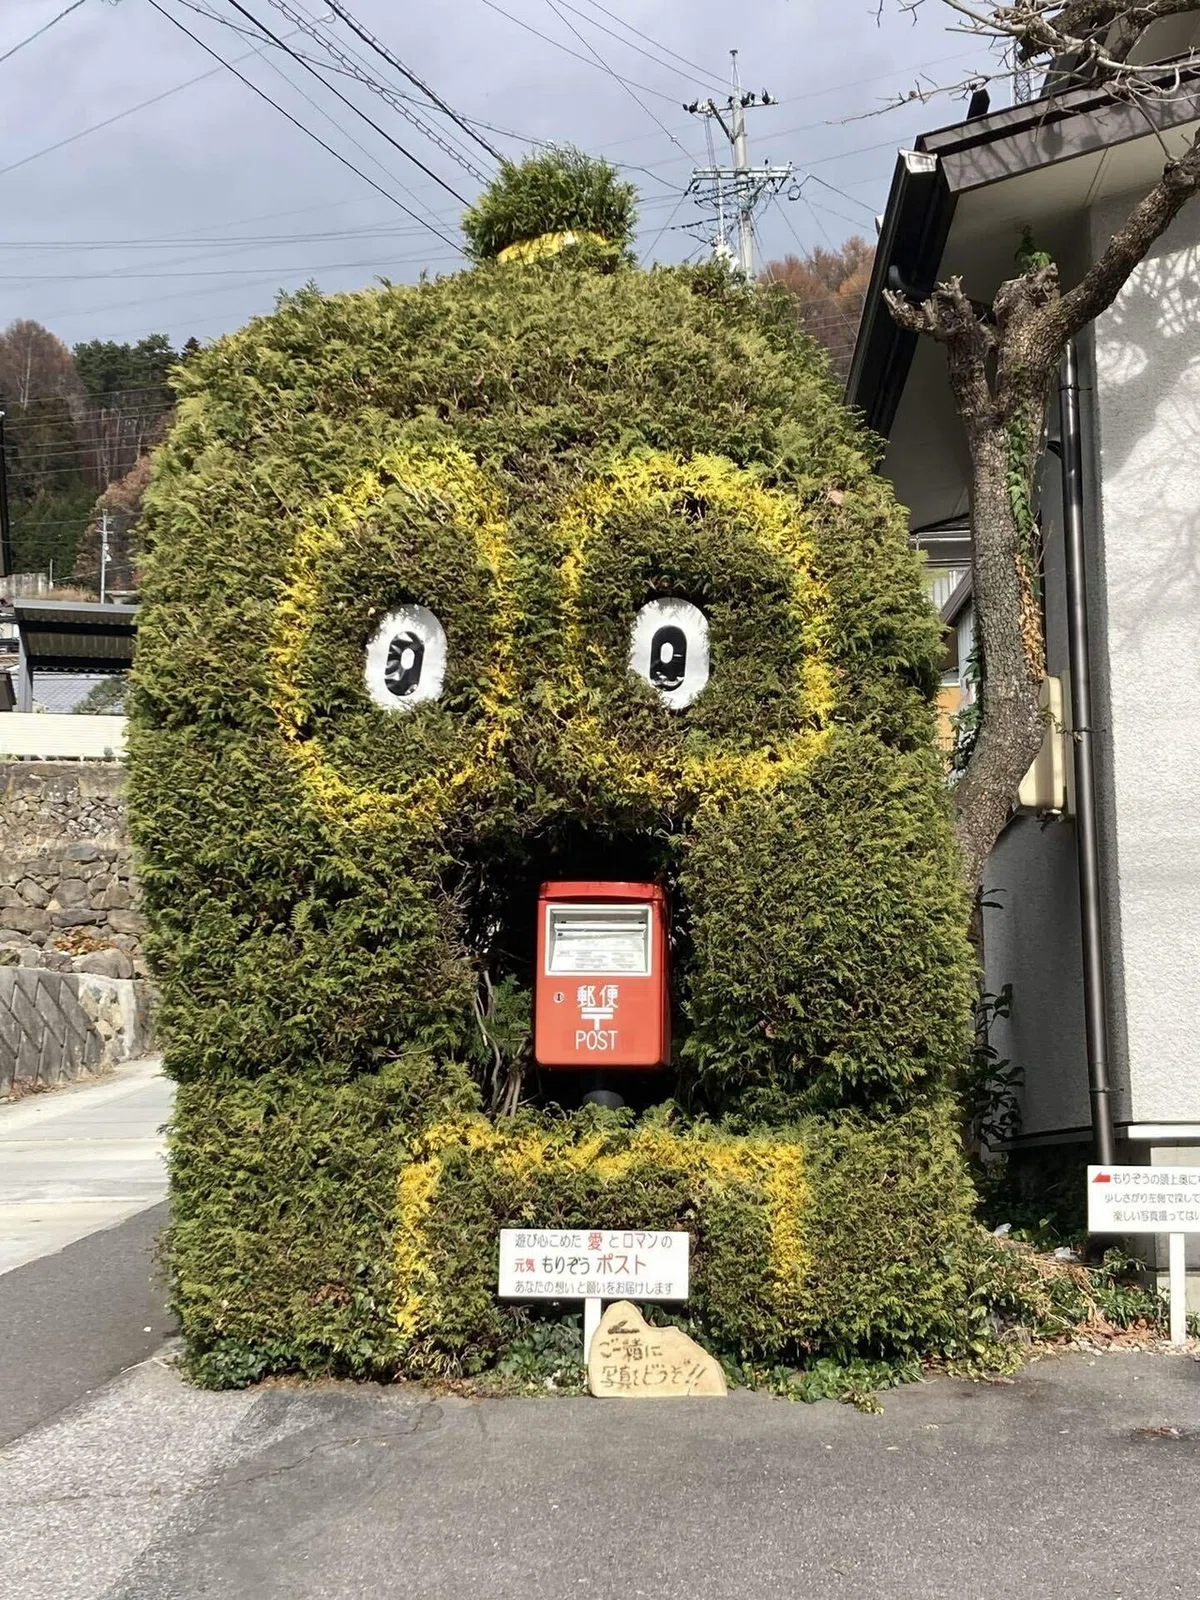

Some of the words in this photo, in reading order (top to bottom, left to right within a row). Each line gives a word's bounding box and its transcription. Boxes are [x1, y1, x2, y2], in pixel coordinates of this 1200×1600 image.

[576, 984, 619, 1008] 郵便
[575, 1029, 619, 1050] POST
[1113, 1173, 1200, 1185] もりぞうの頭上奥に
[542, 1255, 590, 1275] もりぞう
[596, 1253, 646, 1275] ポスト
